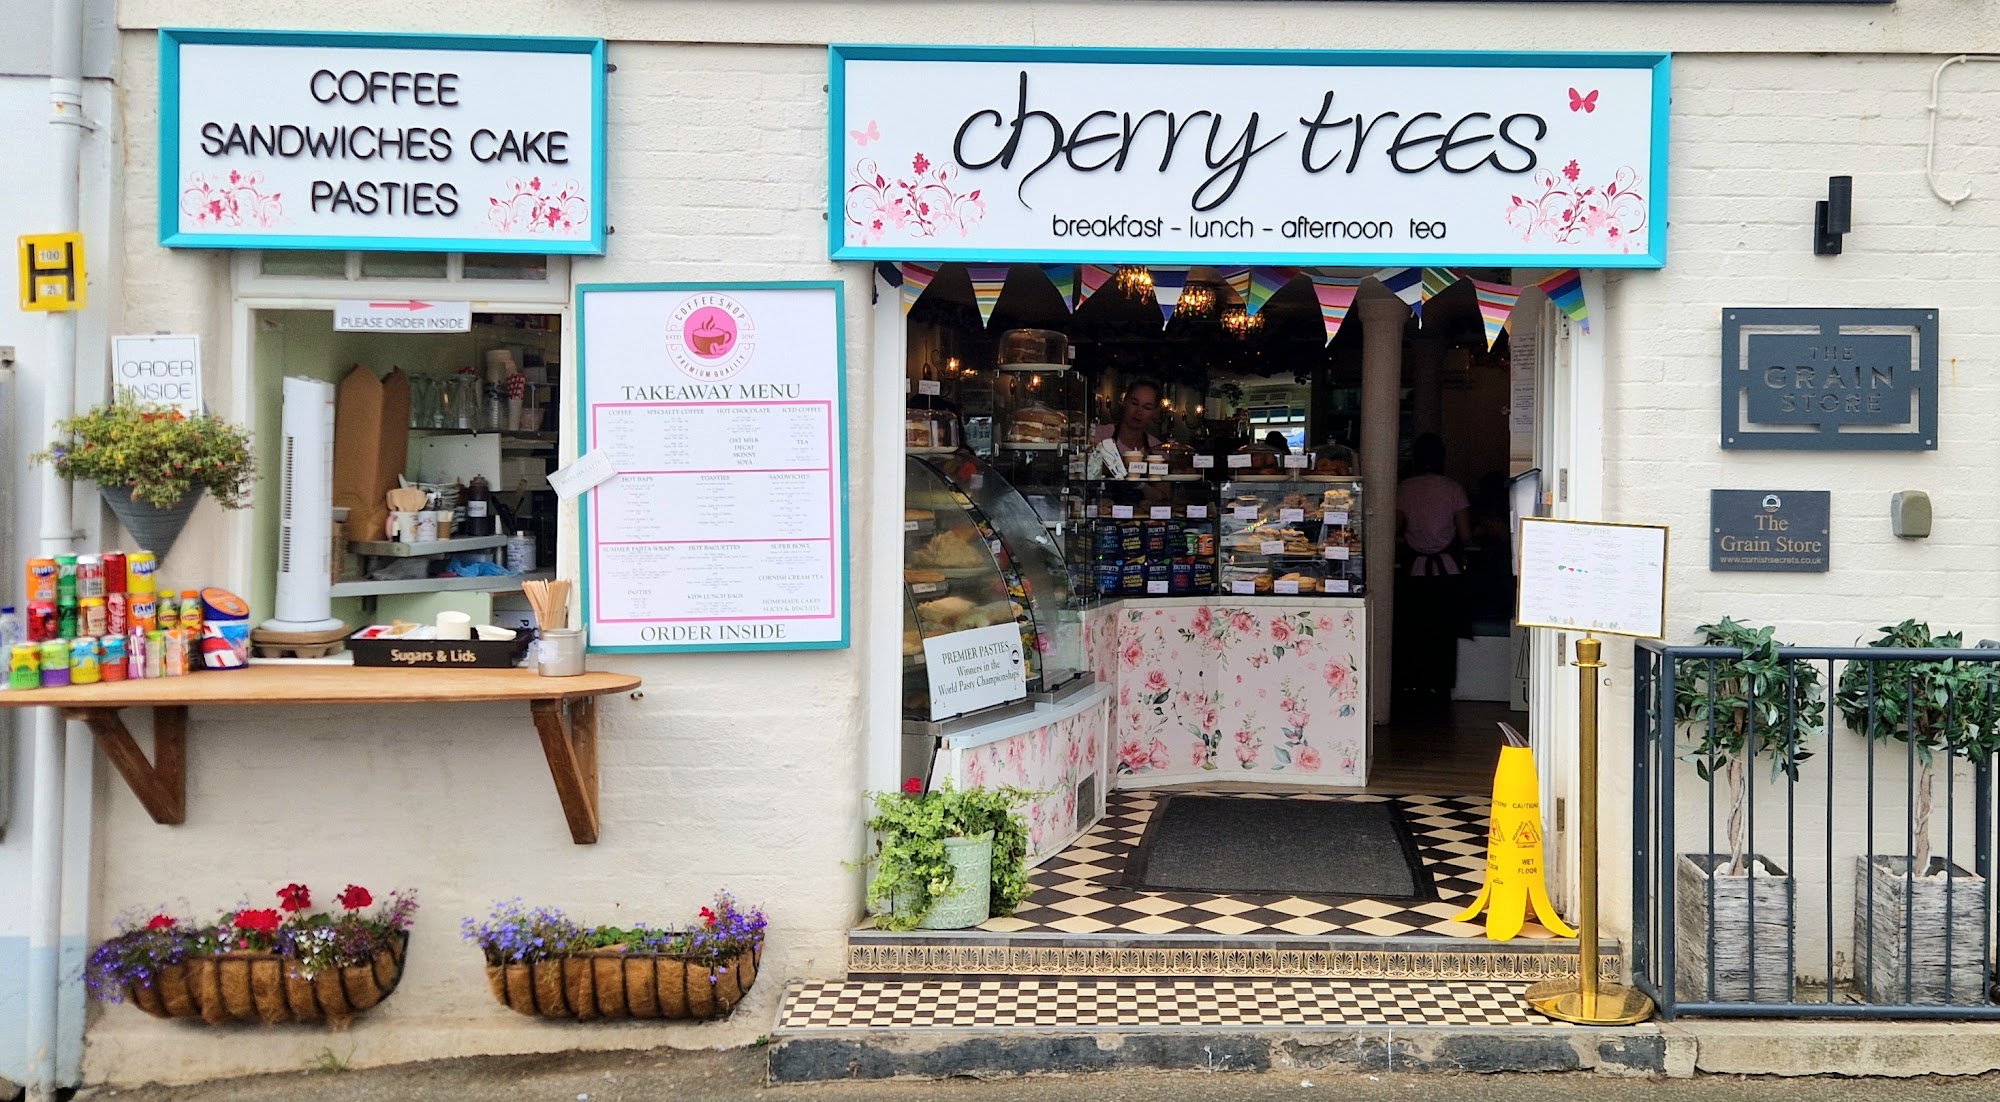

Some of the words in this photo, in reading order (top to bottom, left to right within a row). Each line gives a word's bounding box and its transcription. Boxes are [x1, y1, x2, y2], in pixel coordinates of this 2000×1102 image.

[311, 69, 460, 106] COFFEE
[200, 122, 453, 162] SANDWICHES
[470, 129, 570, 164] CAKE
[953, 71, 1288, 211] cherry
[1300, 90, 1549, 175] trees
[311, 181, 459, 216] PASTIES
[1052, 214, 1164, 239] breakfast
[1190, 214, 1254, 239] lunch
[1281, 215, 1393, 240] afternoon
[1410, 217, 1447, 240] tea
[27, 241, 76, 303] H
[674, 296, 714, 321] COFFEE
[718, 298, 746, 320] SHOP
[341, 317, 383, 329] PLEASE
[386, 318, 425, 329] ORDER
[427, 318, 464, 329] INSIDE
[1809, 346, 1854, 362] THE
[121, 360, 194, 378] ORDER
[675, 355, 711, 378] PREMIUM
[713, 354, 746, 378] QUALITY
[1763, 365, 1895, 390] GRAIN
[127, 383, 192, 400] INSIDE
[621, 384, 733, 400] TAKEAWAY
[739, 383, 801, 400] MENU
[1780, 393, 1882, 413] STORE
[1754, 514, 1789, 531] The
[1721, 535, 1770, 552] Grain
[1776, 536, 1822, 553] Store
[1720, 556, 1823, 564] www.cornishsecrets.co.uk
[640, 625, 713, 641] ORDER
[719, 623, 787, 640] INSIDE
[390, 649, 434, 665] Sugars
[436, 650, 448, 662] &
[450, 649, 477, 663] Lids
[941, 649, 978, 665] PREMIER
[978, 641, 1010, 658] PASTIES
[956, 664, 983, 677] Winners
[983, 662, 990, 672] in
[990, 659, 1001, 669] the
[938, 681, 958, 696] World
[959, 679, 976, 693] Pasty
[976, 669, 1020, 688] Championships
